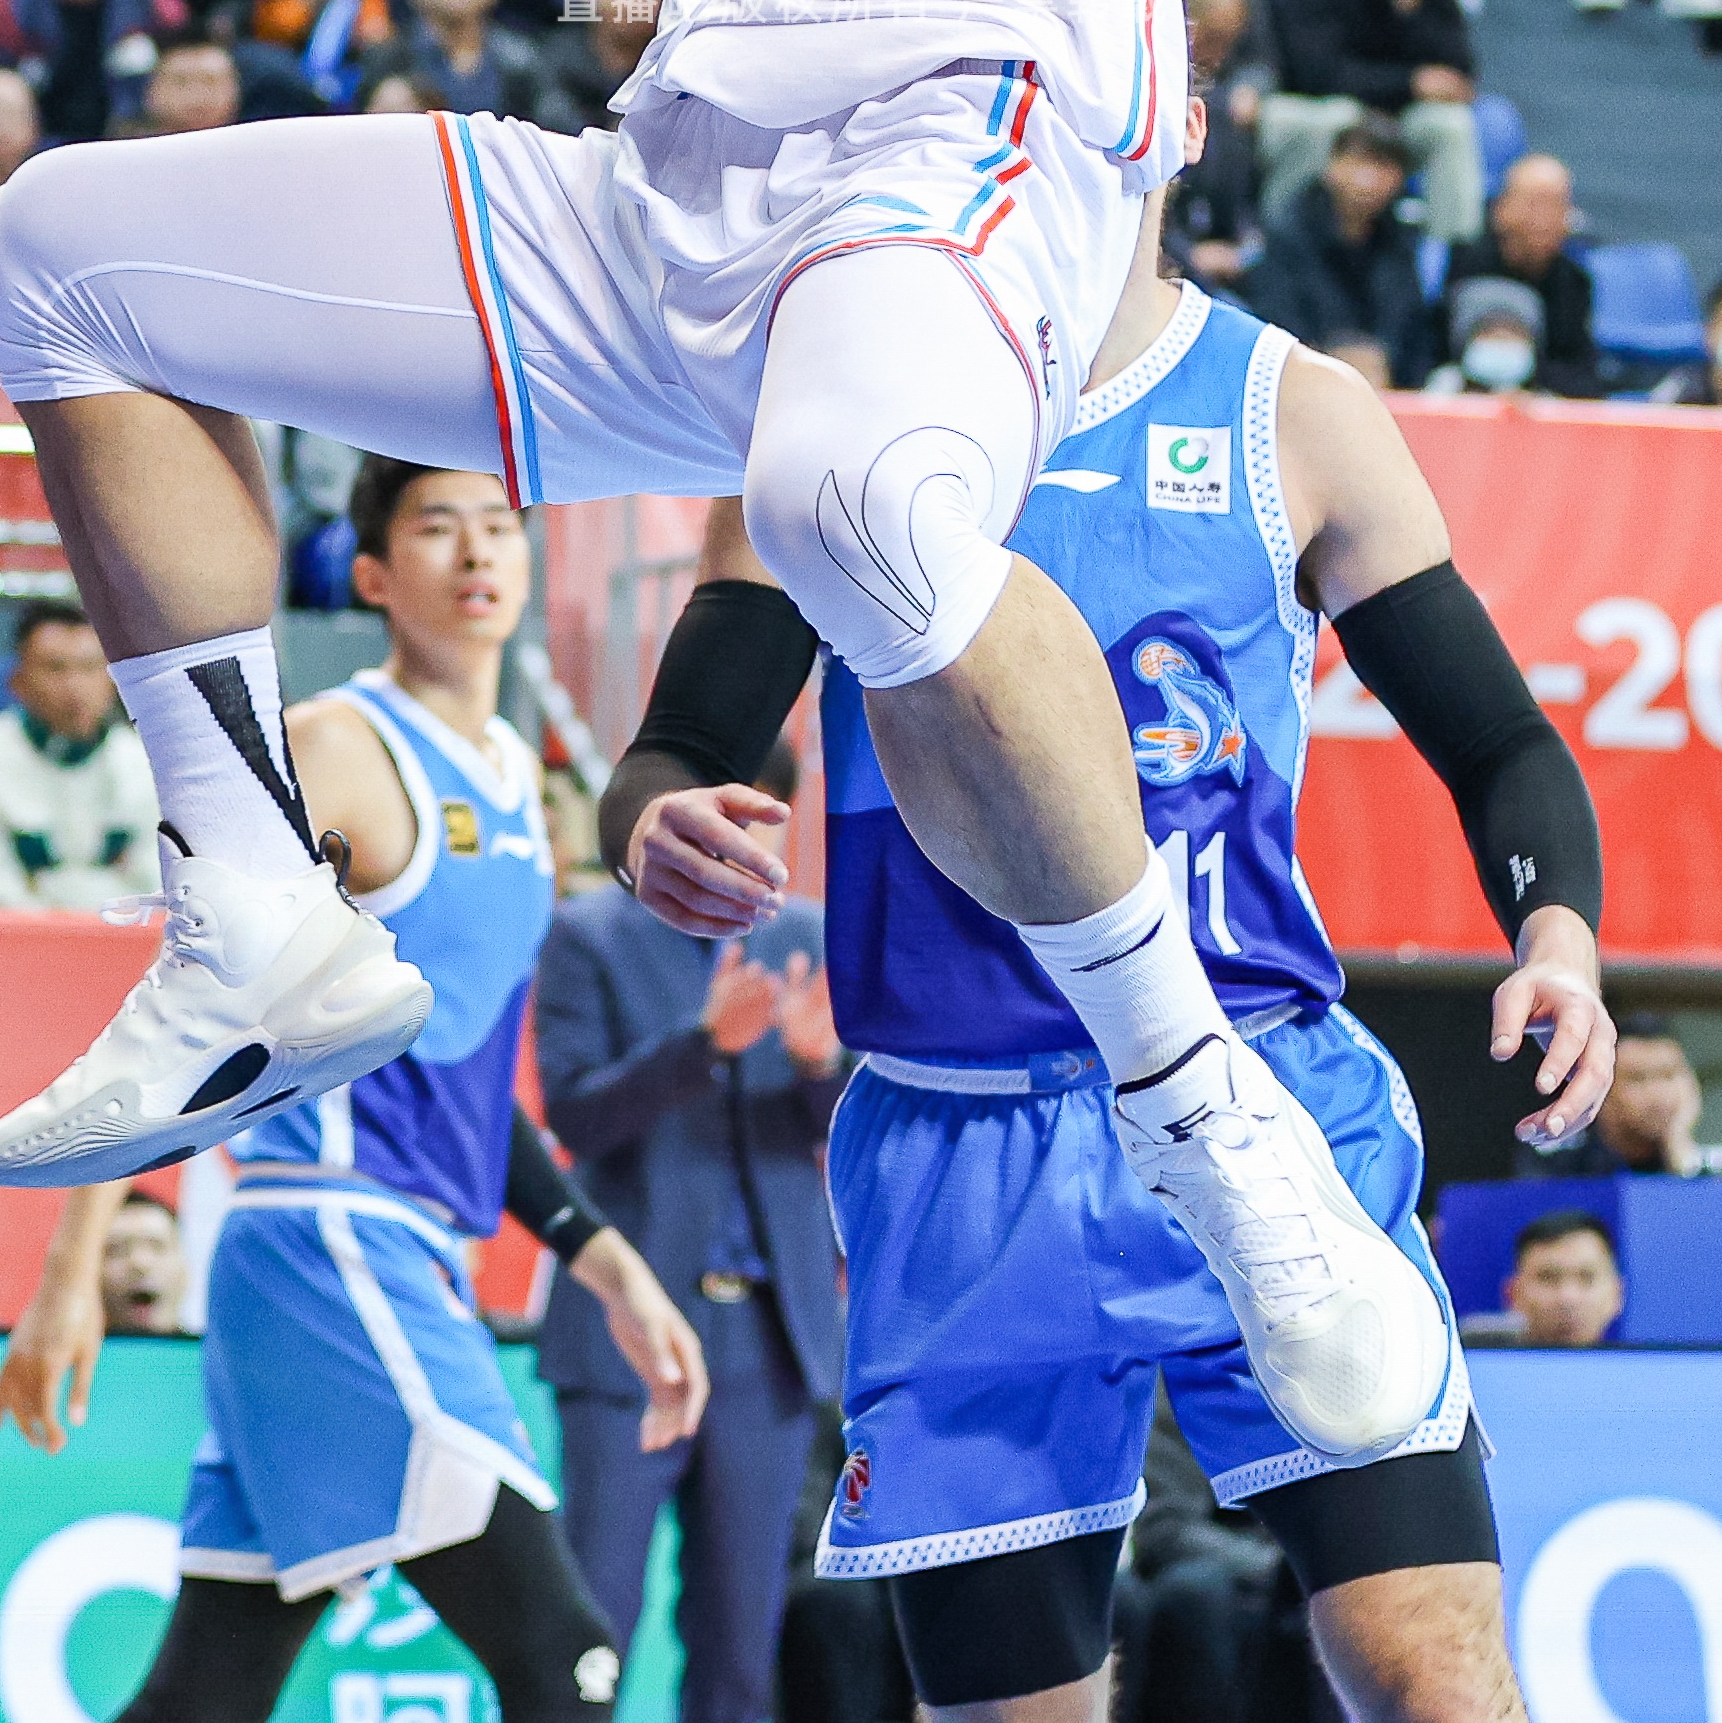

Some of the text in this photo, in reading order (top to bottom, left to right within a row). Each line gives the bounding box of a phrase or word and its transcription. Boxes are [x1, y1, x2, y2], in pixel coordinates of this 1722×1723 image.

[1155, 480, 1221, 493] 中国人寿
[1155, 493, 1221, 504] CHINA LIFE
